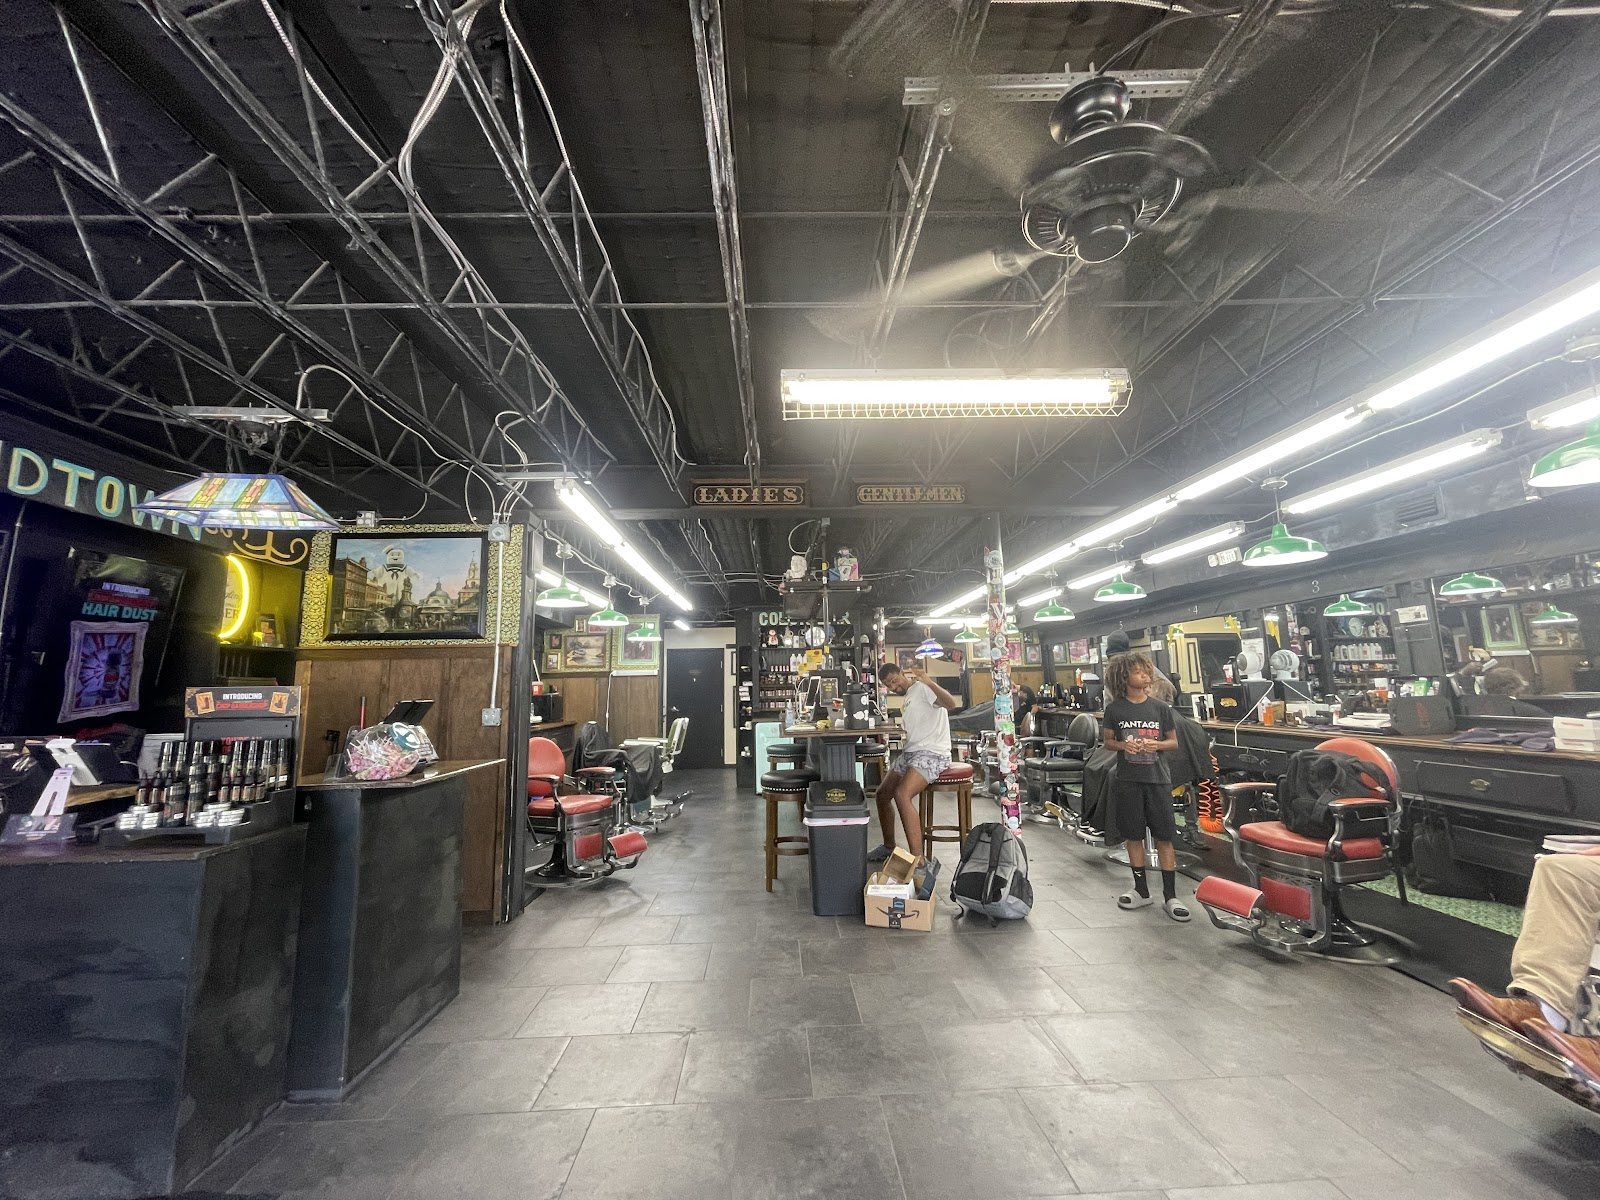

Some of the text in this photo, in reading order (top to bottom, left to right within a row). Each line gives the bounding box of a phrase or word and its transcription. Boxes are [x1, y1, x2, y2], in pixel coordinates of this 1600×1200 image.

[698, 487, 798, 503] LADIES
[858, 486, 963, 502] GENTLEMEN
[1311, 579, 1321, 594] 3
[81, 601, 159, 622] HAIR DUST
[1193, 605, 1199, 615] 4
